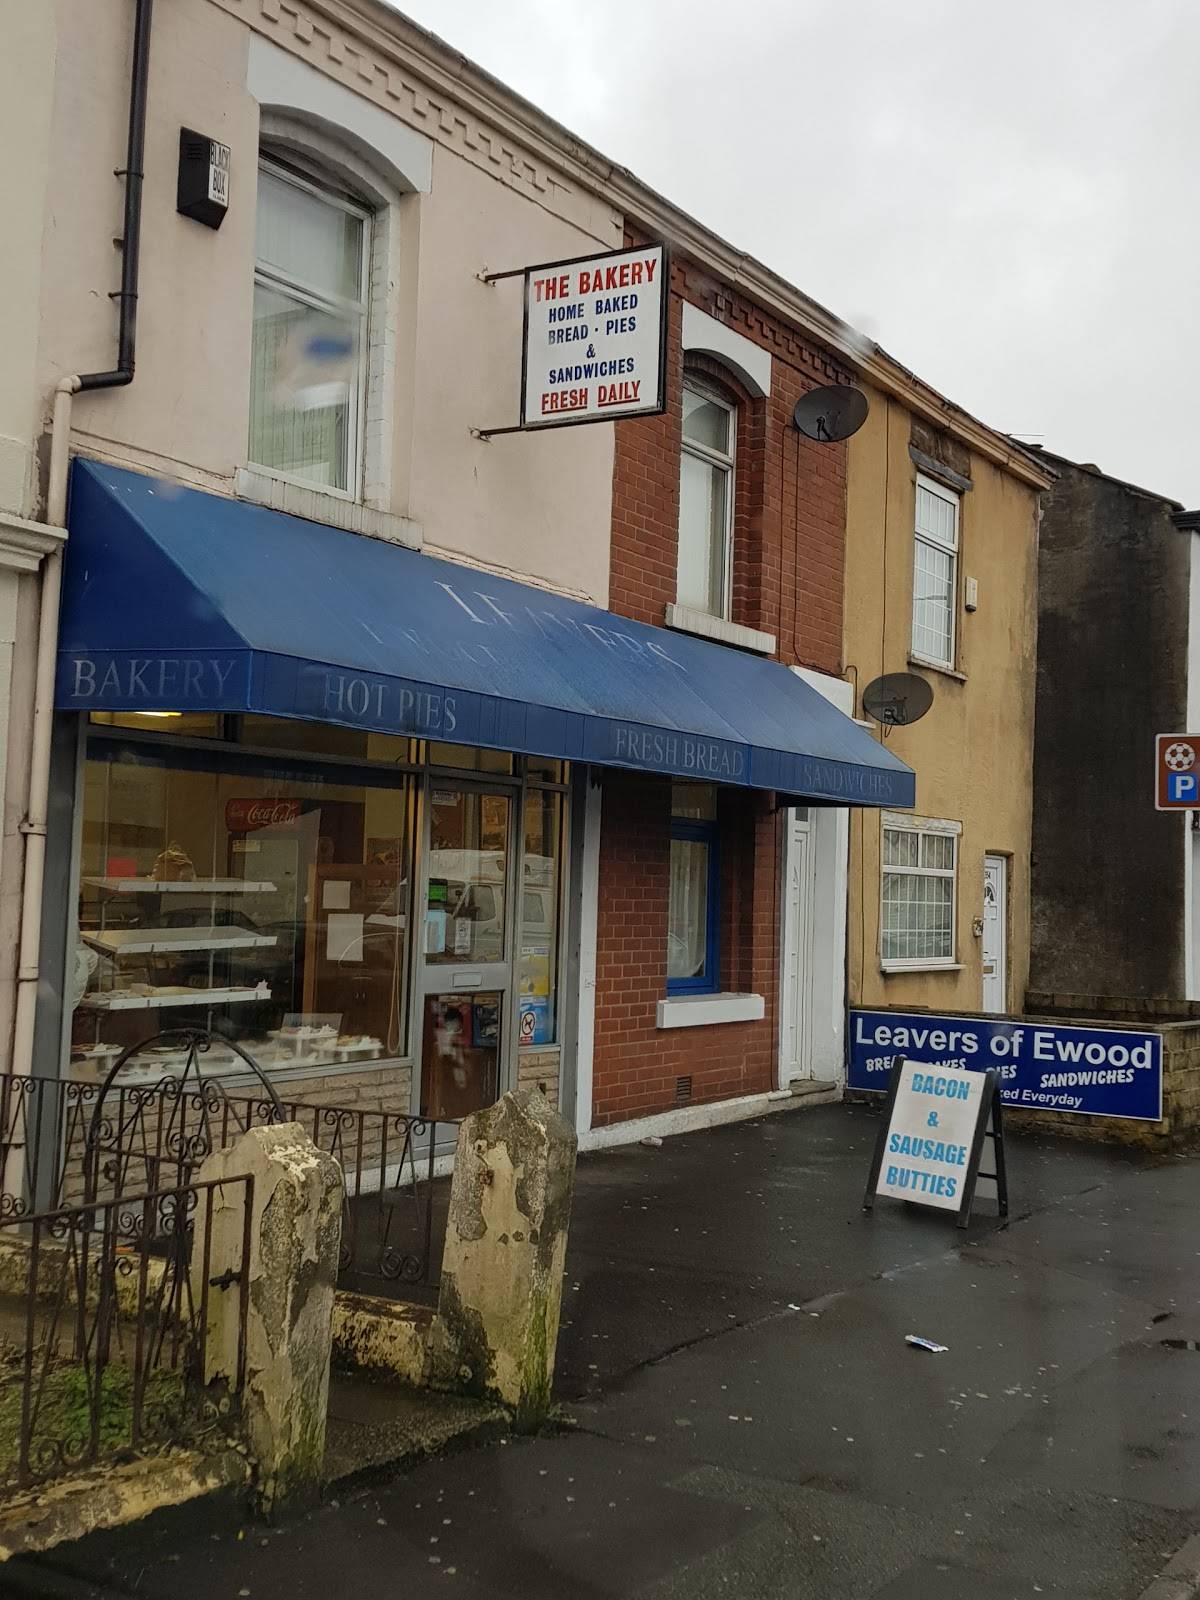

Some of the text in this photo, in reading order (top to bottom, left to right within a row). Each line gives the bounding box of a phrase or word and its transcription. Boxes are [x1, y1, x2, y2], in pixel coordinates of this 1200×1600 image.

[213, 169, 226, 196] BOX
[534, 259, 657, 302] THE BAKERY
[549, 294, 638, 323] HOME BAKED
[548, 316, 637, 345] BREAD PIES
[586, 343, 596, 359] &
[549, 357, 635, 385] SANDWICHES
[541, 380, 641, 412] FRESH DAILY
[71, 658, 236, 698] BAKERY
[323, 671, 457, 732] HOT PIES
[615, 727, 744, 777] FRESH BREAD
[803, 764, 893, 796] SANDWICHES
[1175, 775, 1195, 799] P
[856, 1018, 1152, 1069] Leavers of Ewood
[912, 1073, 970, 1101] BACON
[1040, 1068, 1135, 1088] SANDWICHES
[1022, 1090, 1083, 1108] Everyday
[927, 1111, 939, 1127] &
[889, 1132, 968, 1166] SAUSAGE
[886, 1165, 957, 1198] BUTTIES
